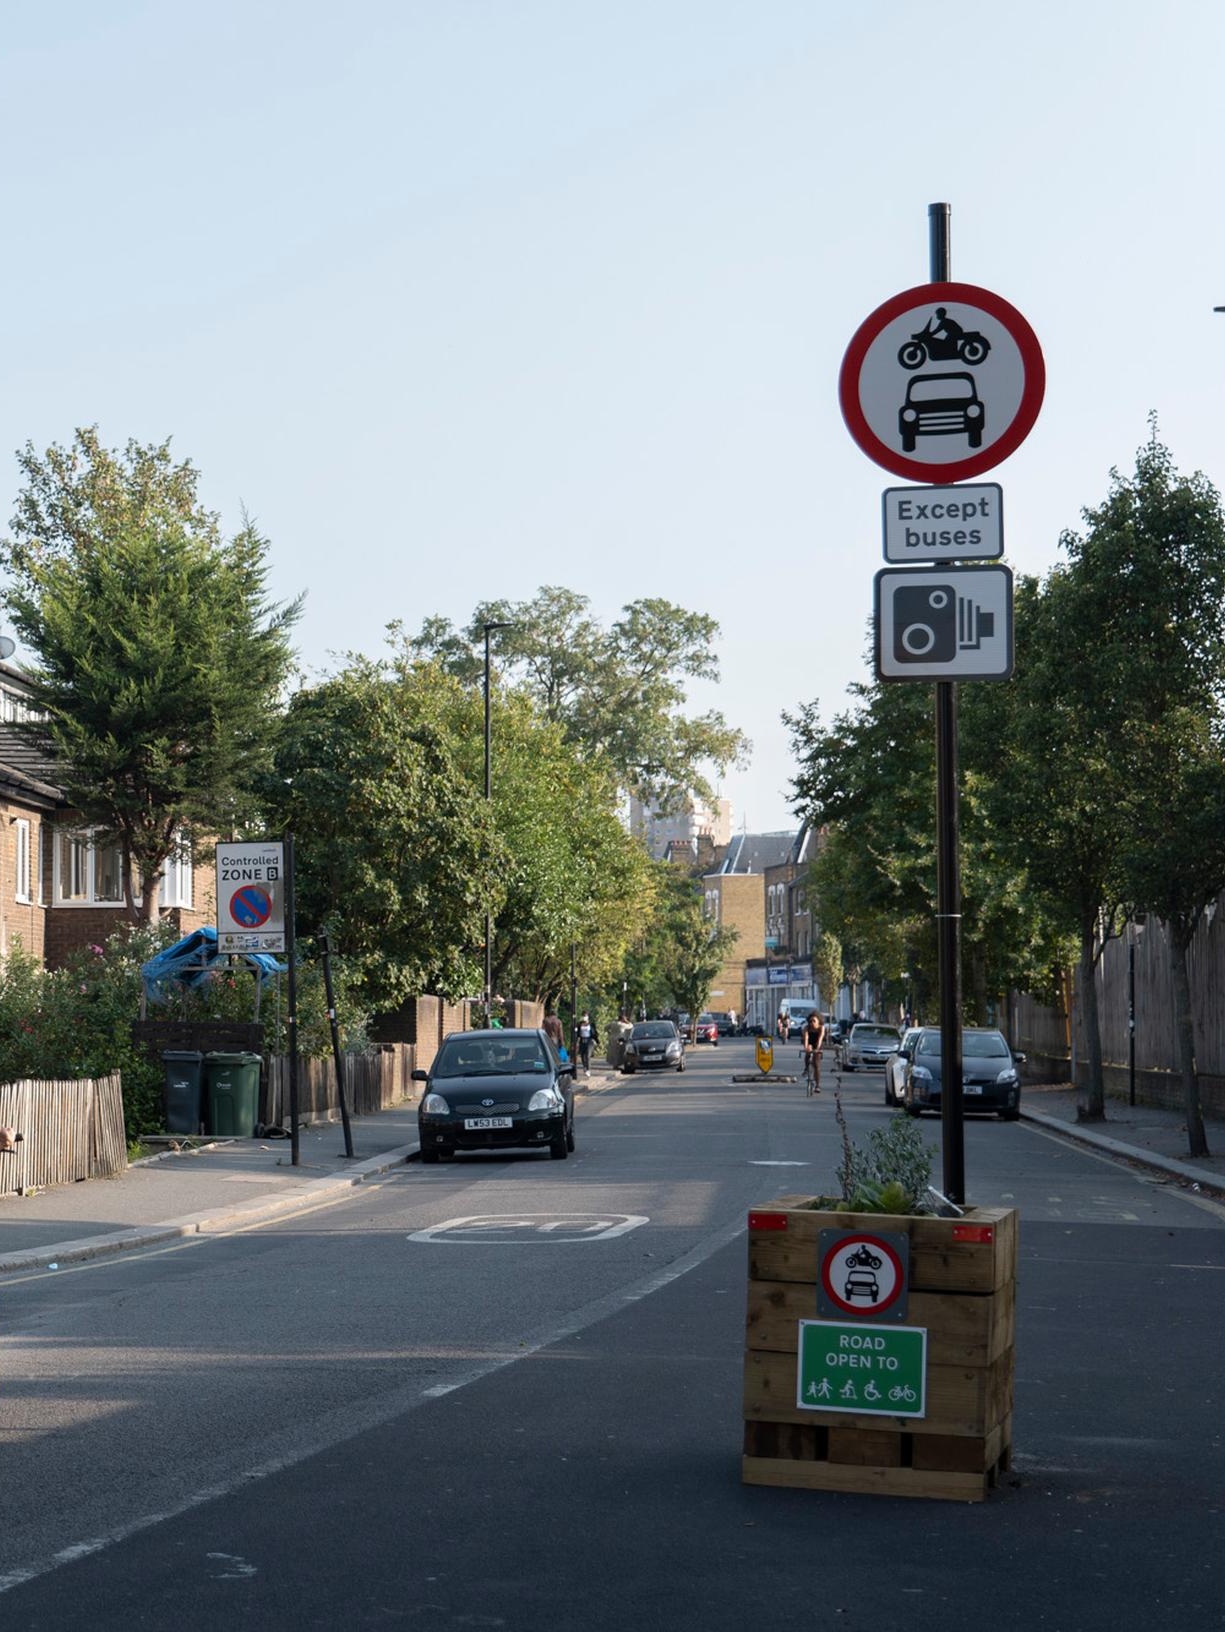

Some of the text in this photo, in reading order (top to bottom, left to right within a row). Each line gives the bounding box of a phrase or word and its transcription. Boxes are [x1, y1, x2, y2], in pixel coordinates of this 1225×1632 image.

[898, 497, 990, 522] Except
[905, 527, 982, 547] buses
[221, 856, 279, 866] Controlled
[222, 868, 278, 881] ZONE B
[445, 1220, 615, 1234] 20
[839, 1335, 886, 1350] ROAD
[825, 1352, 899, 1370] OPEN TO
